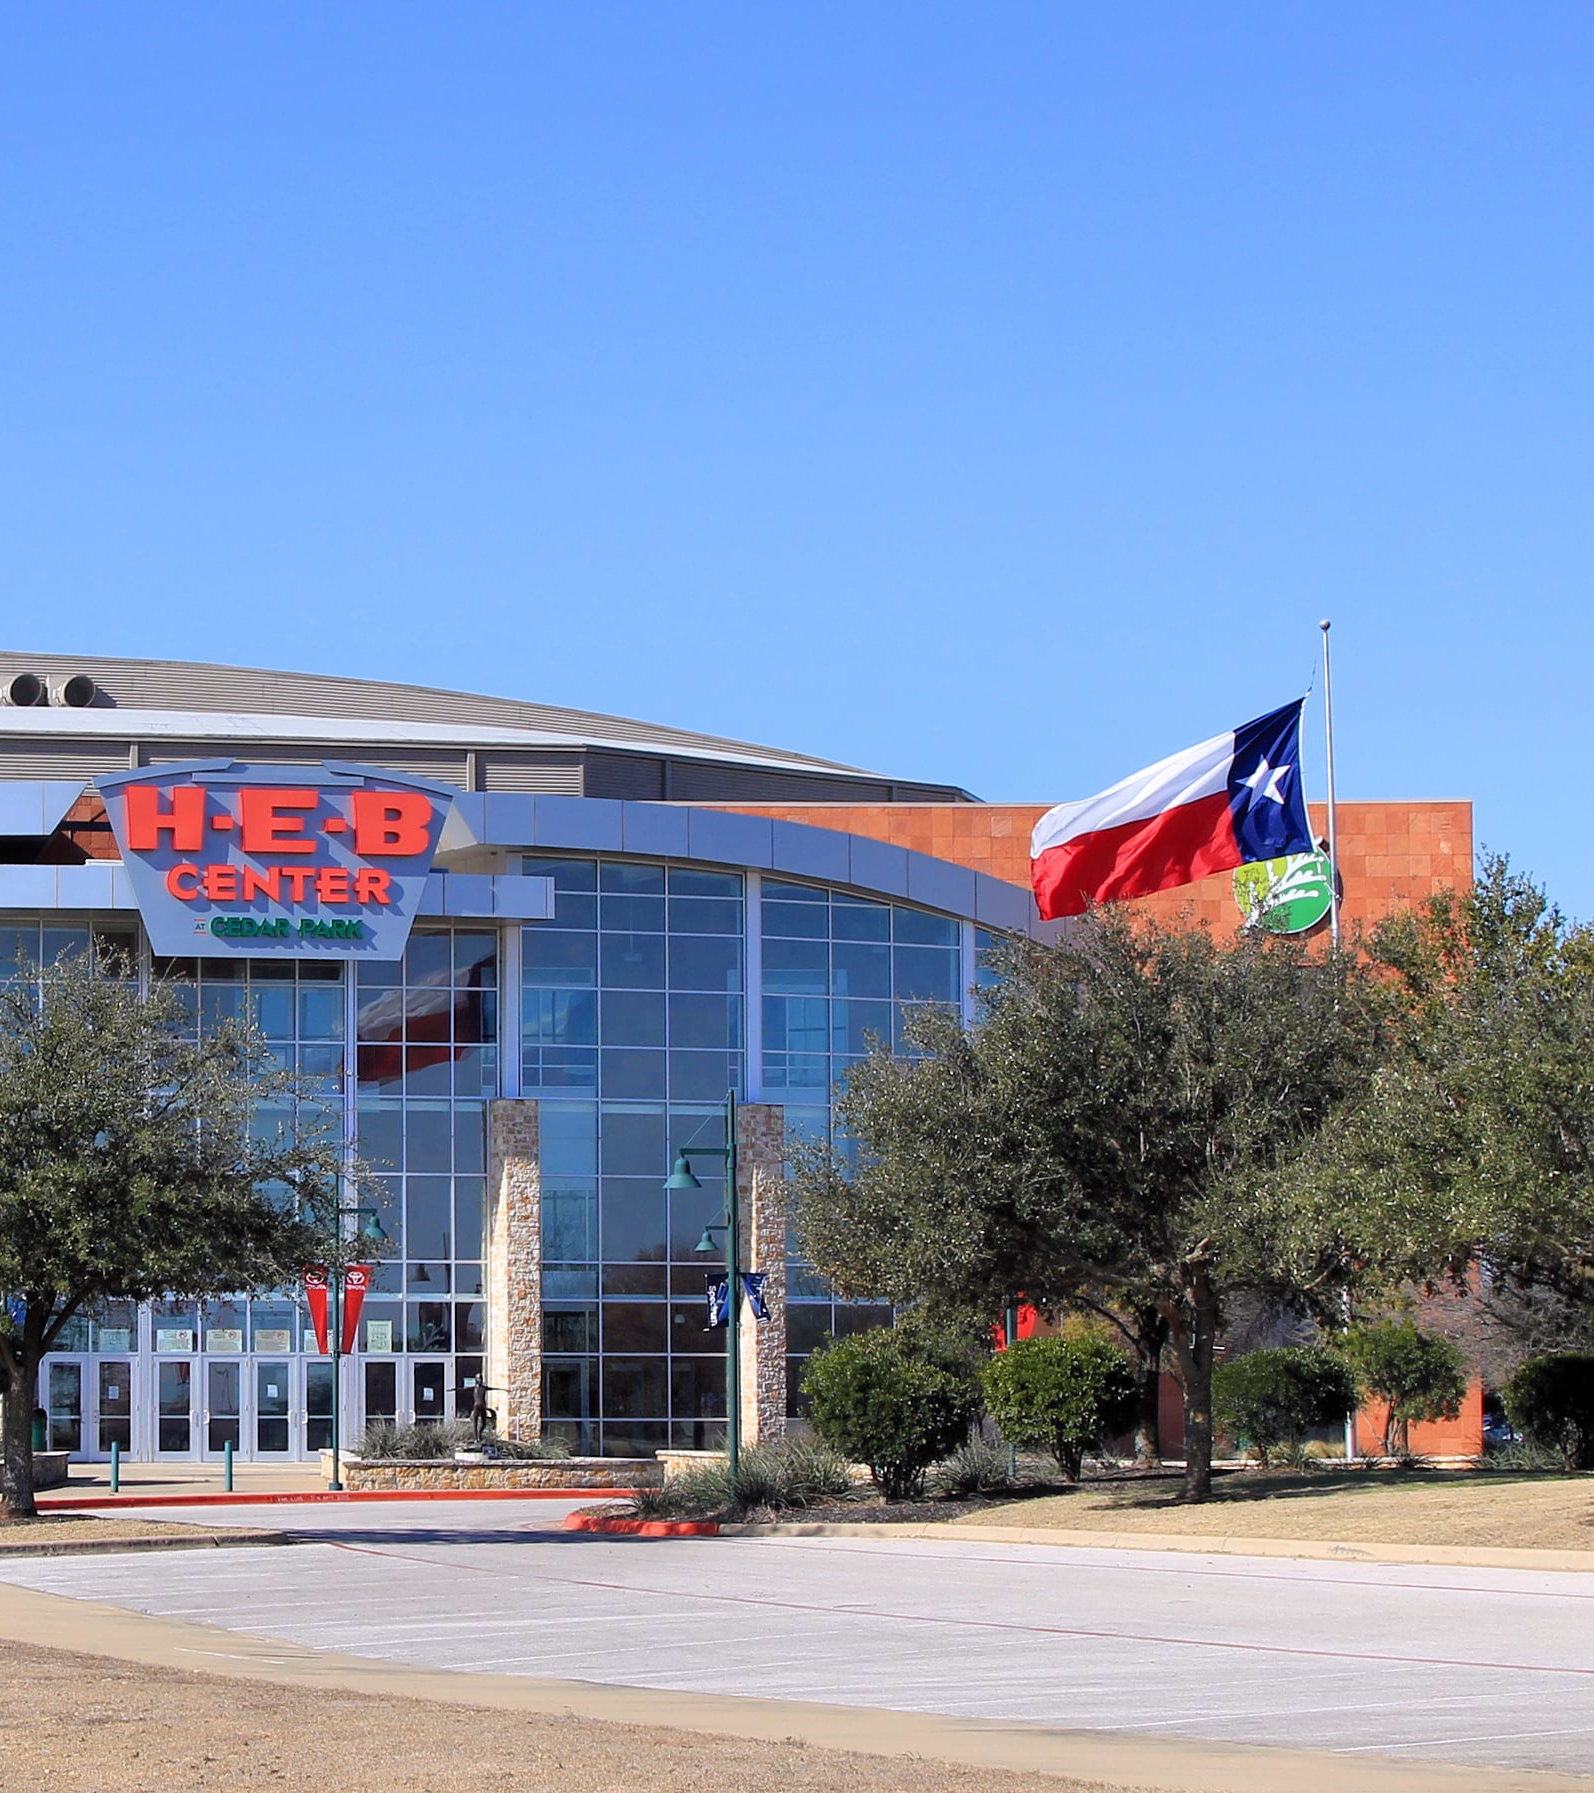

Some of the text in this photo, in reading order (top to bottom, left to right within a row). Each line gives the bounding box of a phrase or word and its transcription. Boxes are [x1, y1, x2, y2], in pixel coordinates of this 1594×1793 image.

[166, 864, 391, 904] CENTER
[195, 923, 206, 931] AT
[209, 916, 365, 939] CEDAR PARK
